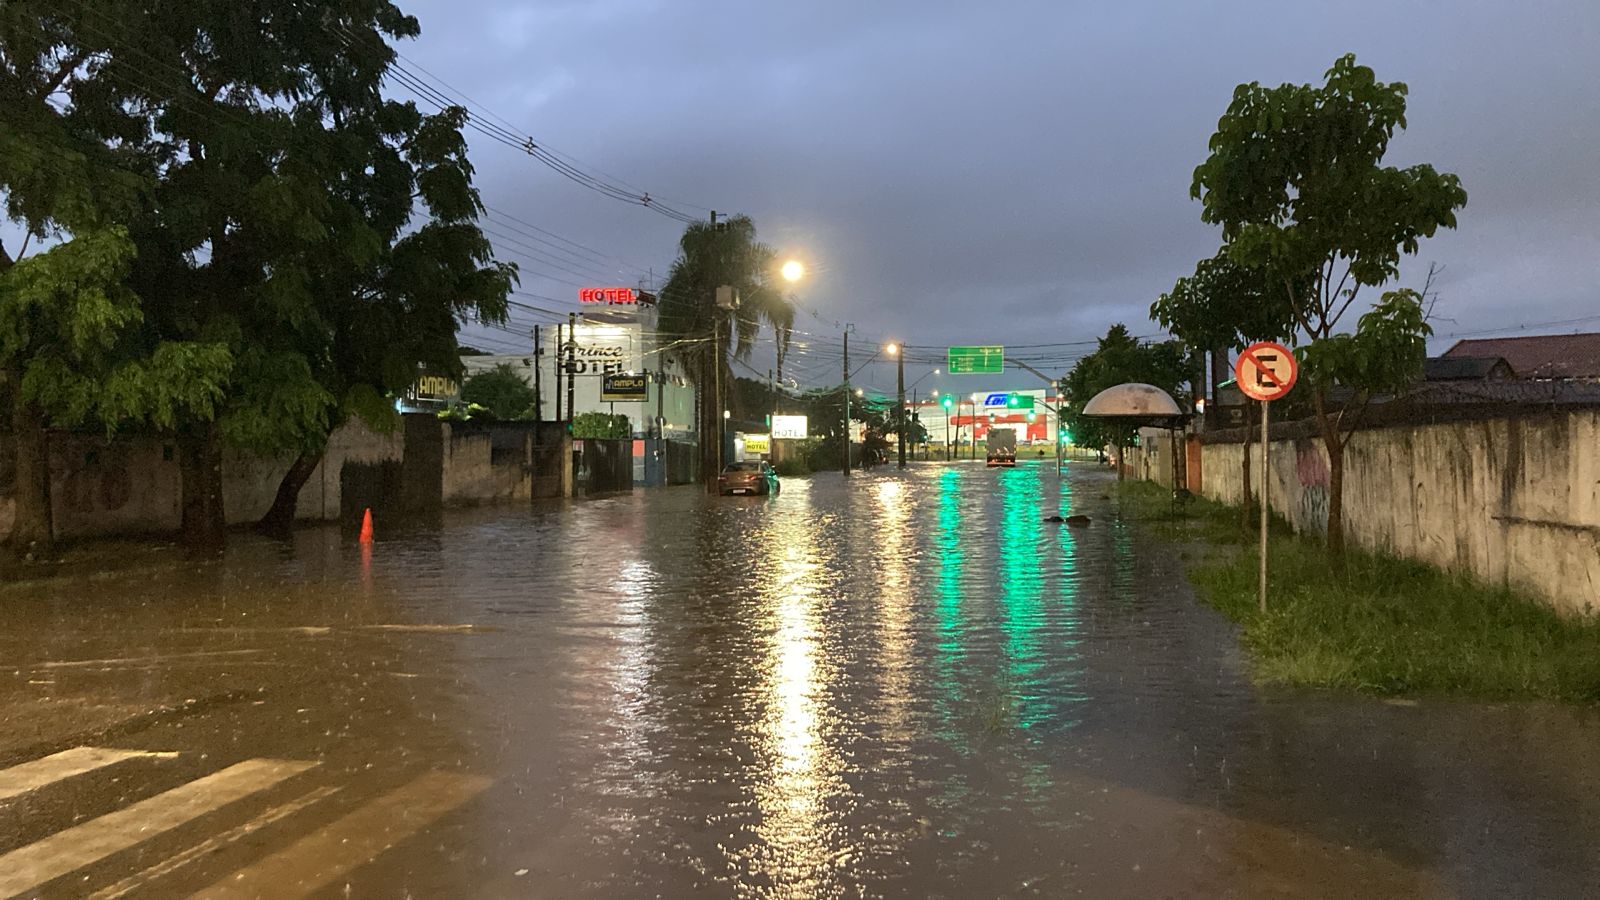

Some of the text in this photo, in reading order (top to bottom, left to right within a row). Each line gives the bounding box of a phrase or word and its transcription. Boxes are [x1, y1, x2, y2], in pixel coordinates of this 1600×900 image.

[579, 288, 637, 303] HOTEL
[1256, 355, 1277, 387] E
[774, 429, 805, 437] HOTEL
